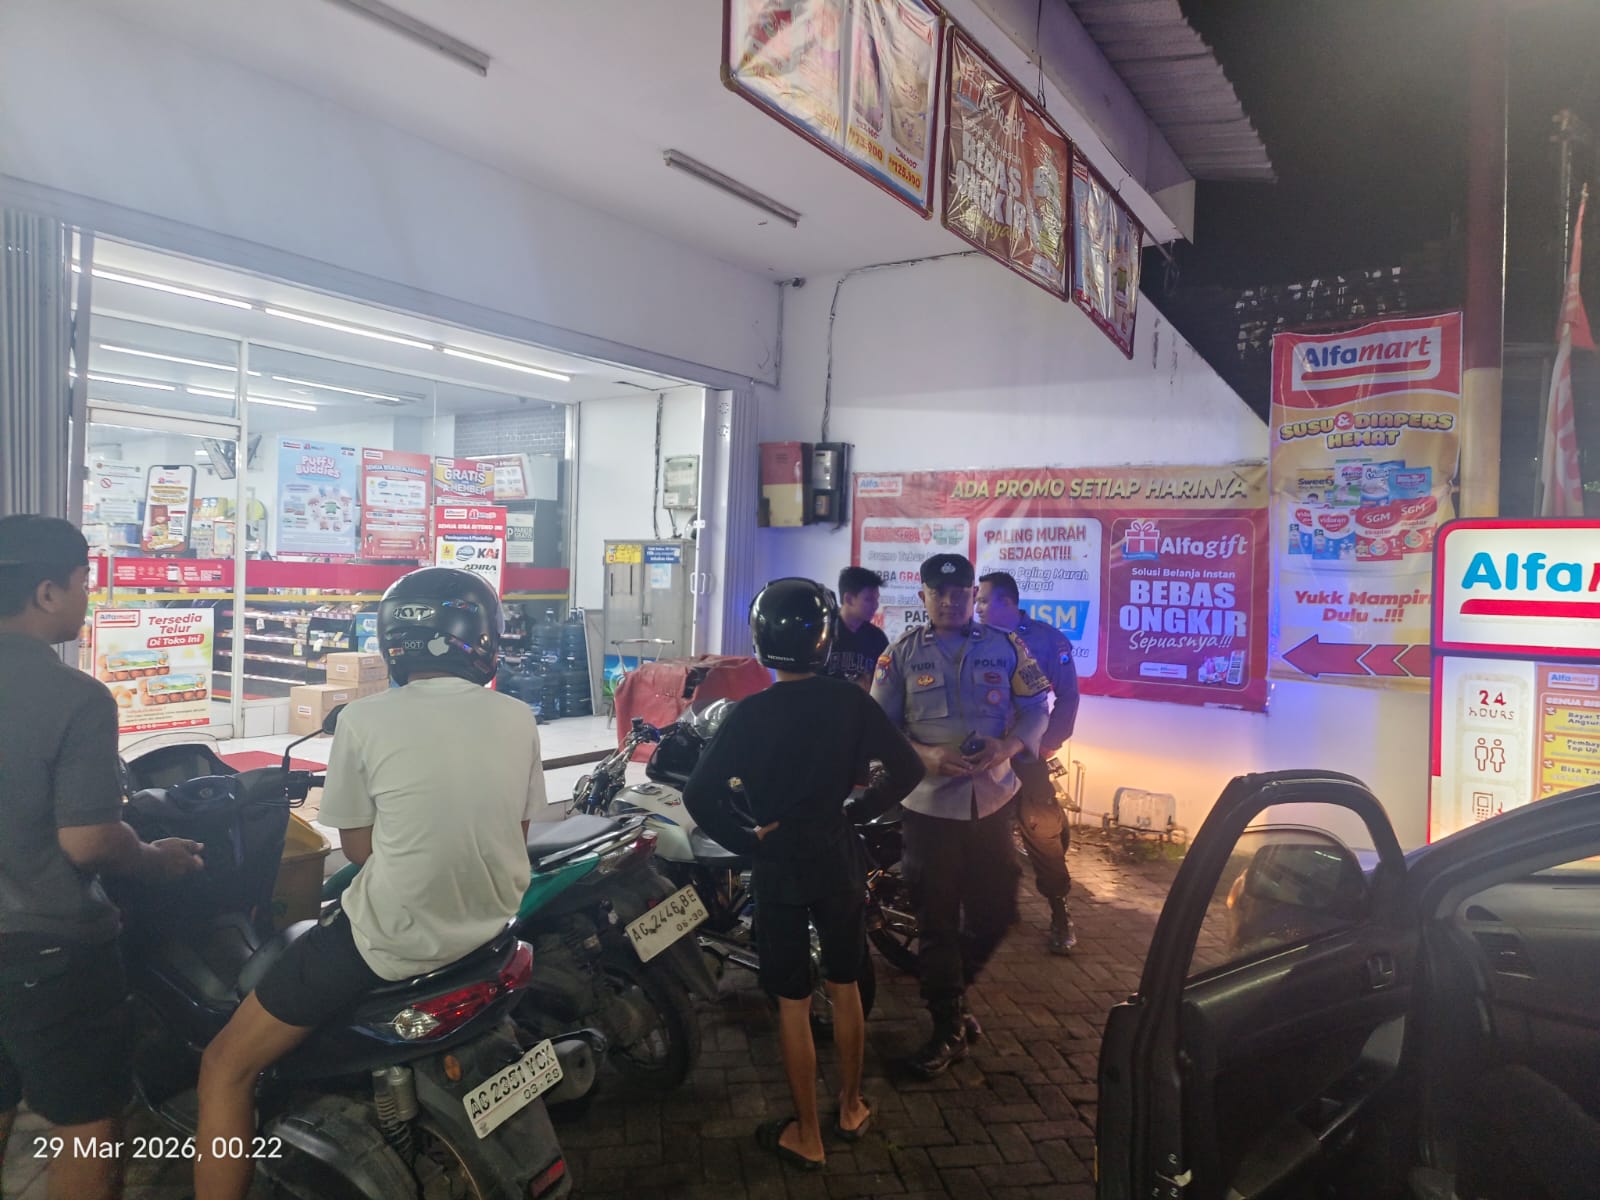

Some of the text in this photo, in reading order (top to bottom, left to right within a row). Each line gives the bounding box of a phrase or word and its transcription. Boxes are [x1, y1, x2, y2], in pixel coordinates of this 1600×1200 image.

[1303, 336, 1432, 367] Alfamart
[1280, 418, 1335, 440] SUSU
[1354, 412, 1454, 431] DIAPERS
[1326, 430, 1401, 450] HEMAT
[444, 468, 486, 483] GRATIS
[951, 477, 1248, 500] ADA PROMO SETIAP HARINYA
[1401, 503, 1427, 516] SGM
[1366, 512, 1392, 524] SGM
[985, 526, 1087, 544] PALING MURAH
[999, 546, 1072, 561] SEJAGAT!!!
[1160, 533, 1249, 559] Alfagift
[1017, 567, 1052, 580] Paling
[1053, 567, 1089, 581] Murah
[1132, 567, 1236, 580] Solusi Belanja Instan
[1130, 579, 1236, 609] BEBAS
[1296, 590, 1344, 605] Yukk
[148, 613, 203, 626] Tersedia
[1119, 604, 1248, 638] ONGKIR
[1322, 608, 1369, 622] Dulu
[160, 624, 192, 635] Telur
[149, 635, 201, 647] Di Toko Ini
[404, 641, 422, 649] DOT
[911, 662, 935, 672] YUDI
[974, 658, 1007, 668] POLRI
[1479, 690, 1507, 706] 24
[632, 922, 650, 943] AG
[679, 890, 698, 909] BE
[470, 1091, 491, 1120] AG
